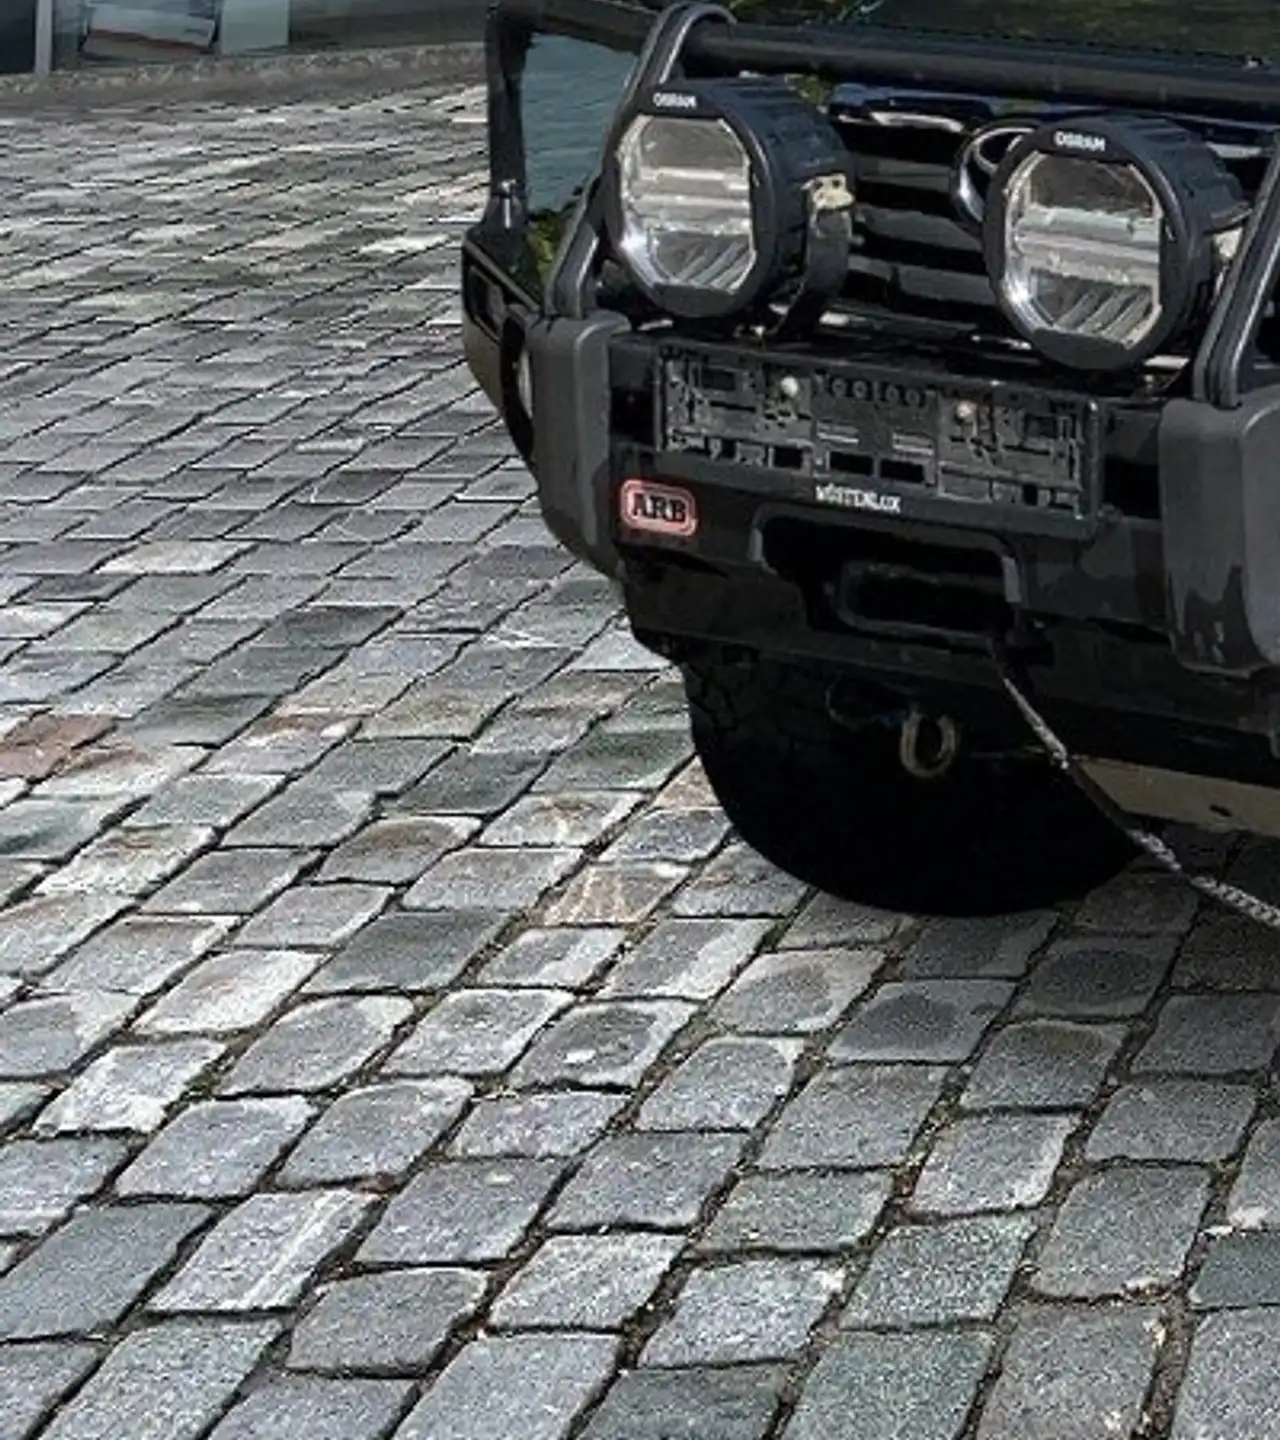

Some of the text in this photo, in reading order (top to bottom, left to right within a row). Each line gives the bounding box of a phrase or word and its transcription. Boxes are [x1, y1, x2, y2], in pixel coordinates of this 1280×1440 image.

[652, 92, 697, 108] OSRAM
[1053, 130, 1106, 152] OSRAM
[630, 491, 688, 524] ARB
